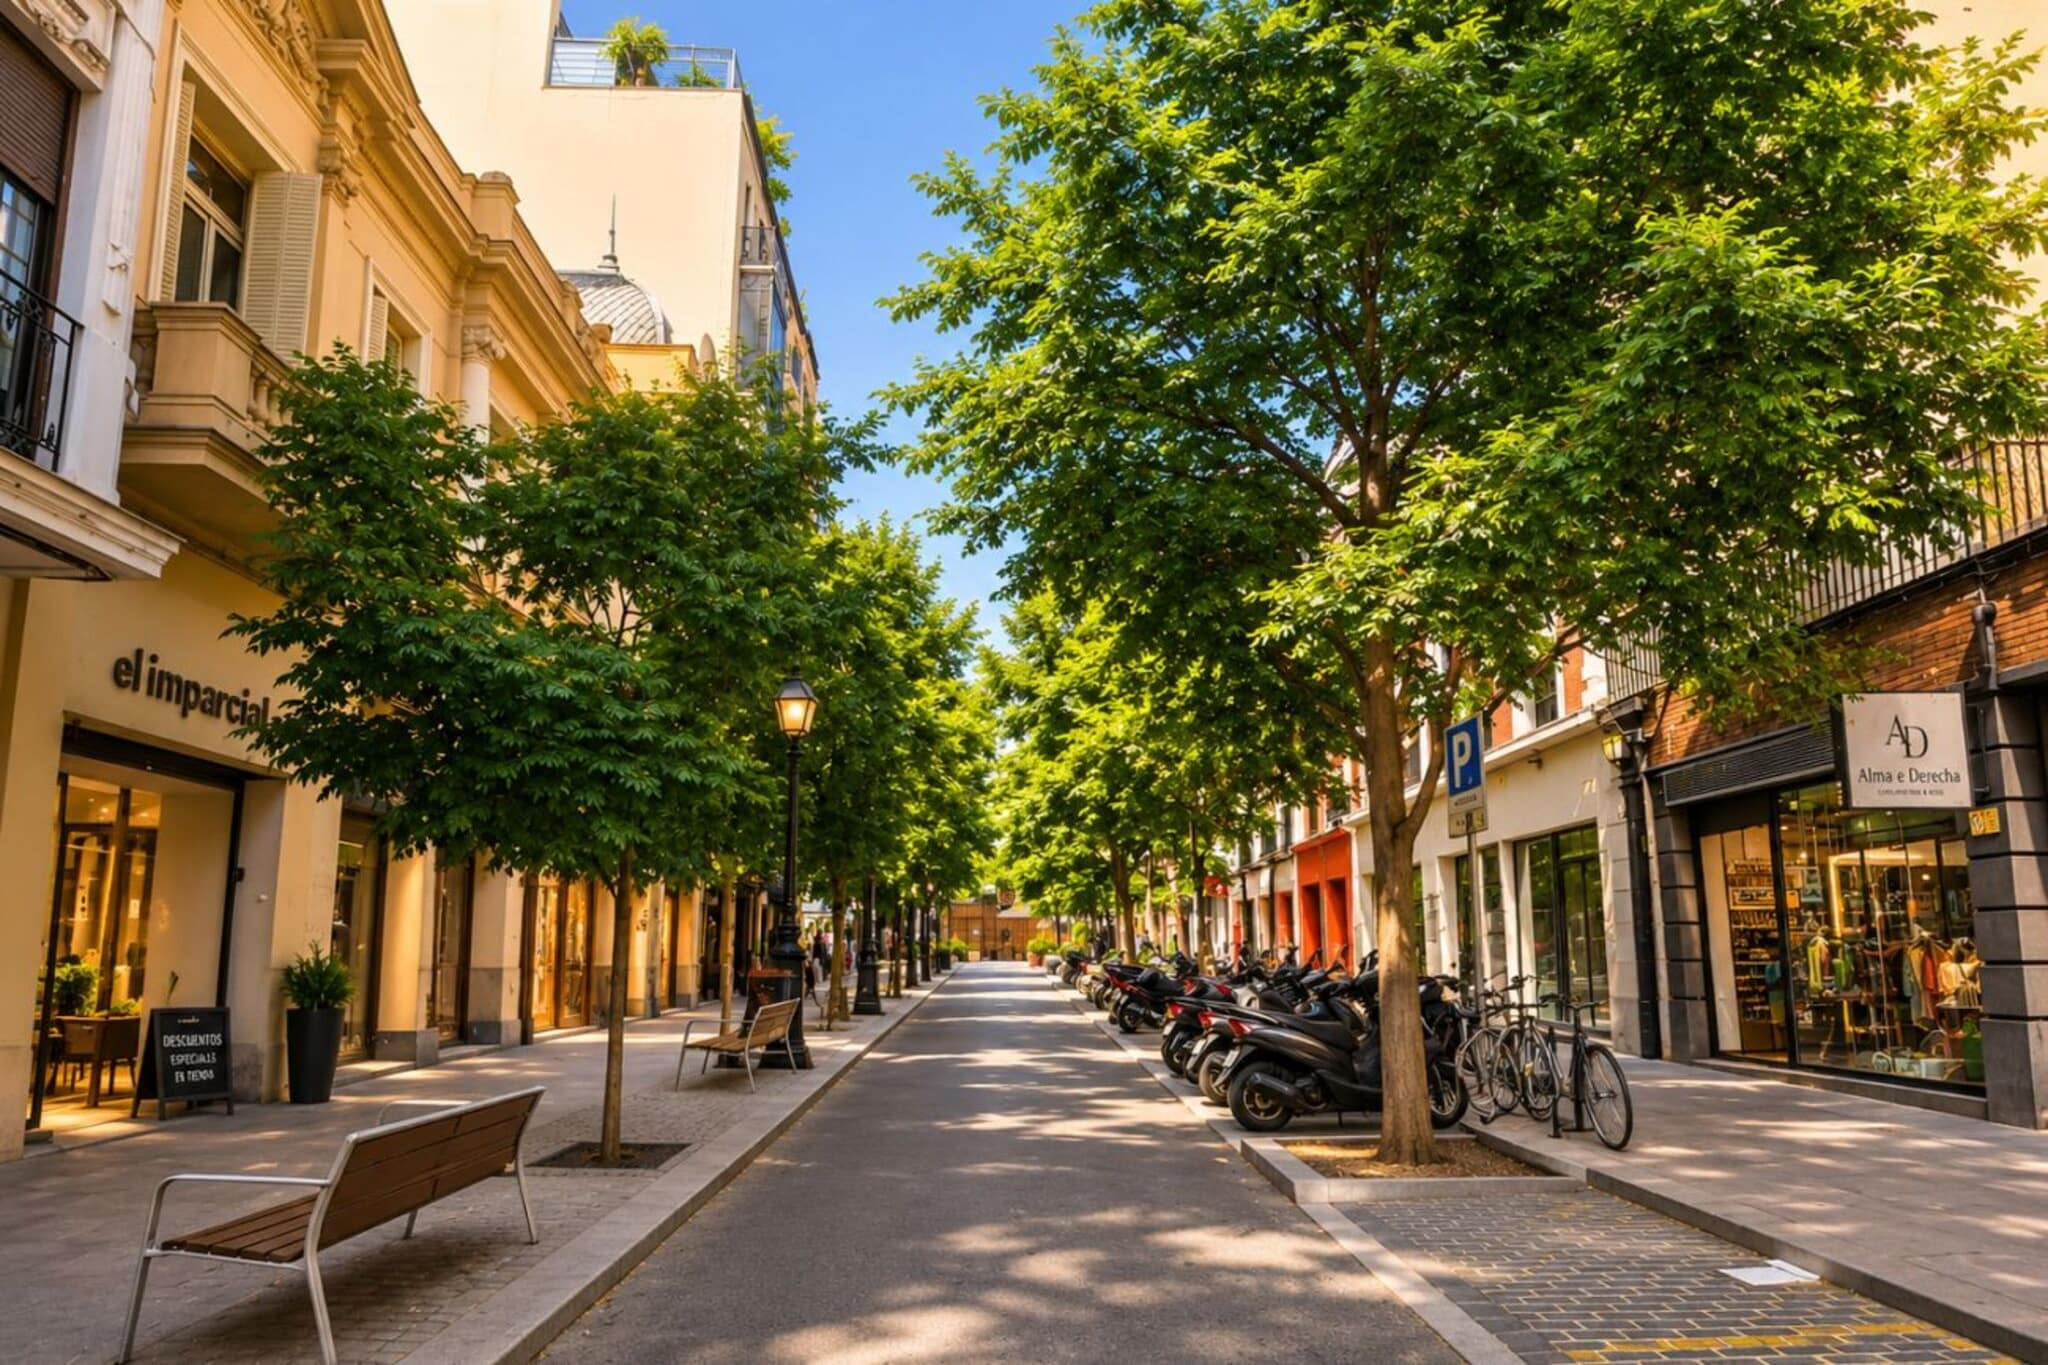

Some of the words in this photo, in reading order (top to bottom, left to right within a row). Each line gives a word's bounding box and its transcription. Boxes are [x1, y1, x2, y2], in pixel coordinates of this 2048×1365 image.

[113, 648, 144, 692] el
[146, 653, 270, 726] imparcial
[1452, 731, 1472, 788] P
[1858, 767, 1892, 783] Alma
[1897, 771, 1905, 783] e
[1909, 767, 1961, 783] Derecha
[163, 1033, 223, 1048] DESCUENTOS
